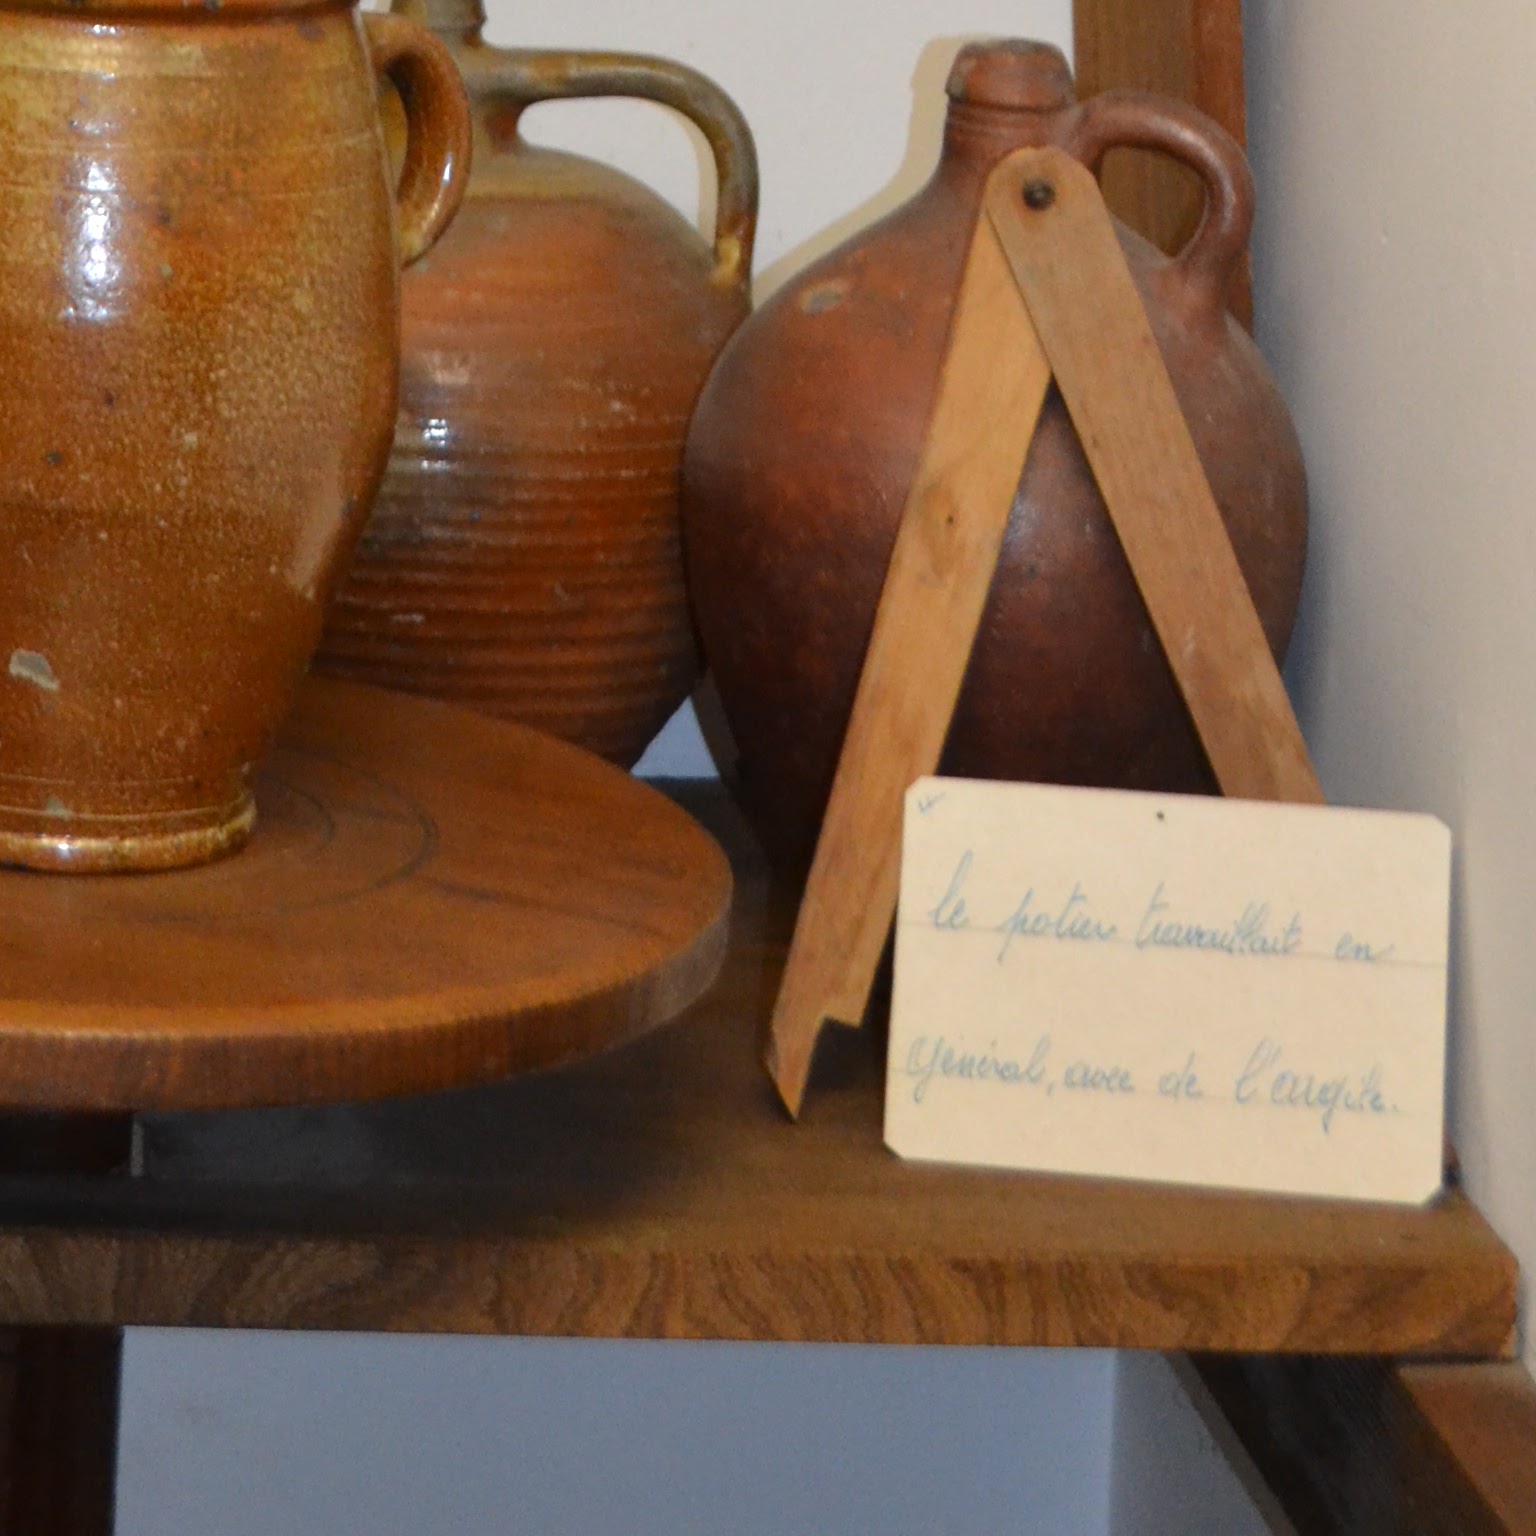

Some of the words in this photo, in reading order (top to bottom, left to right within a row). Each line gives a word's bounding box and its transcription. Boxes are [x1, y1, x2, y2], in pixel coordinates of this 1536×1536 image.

[997, 886, 1119, 964] potier
[1334, 931, 1397, 962] en
[1064, 1059, 1137, 1093] avec
[1157, 1049, 1204, 1100] de
